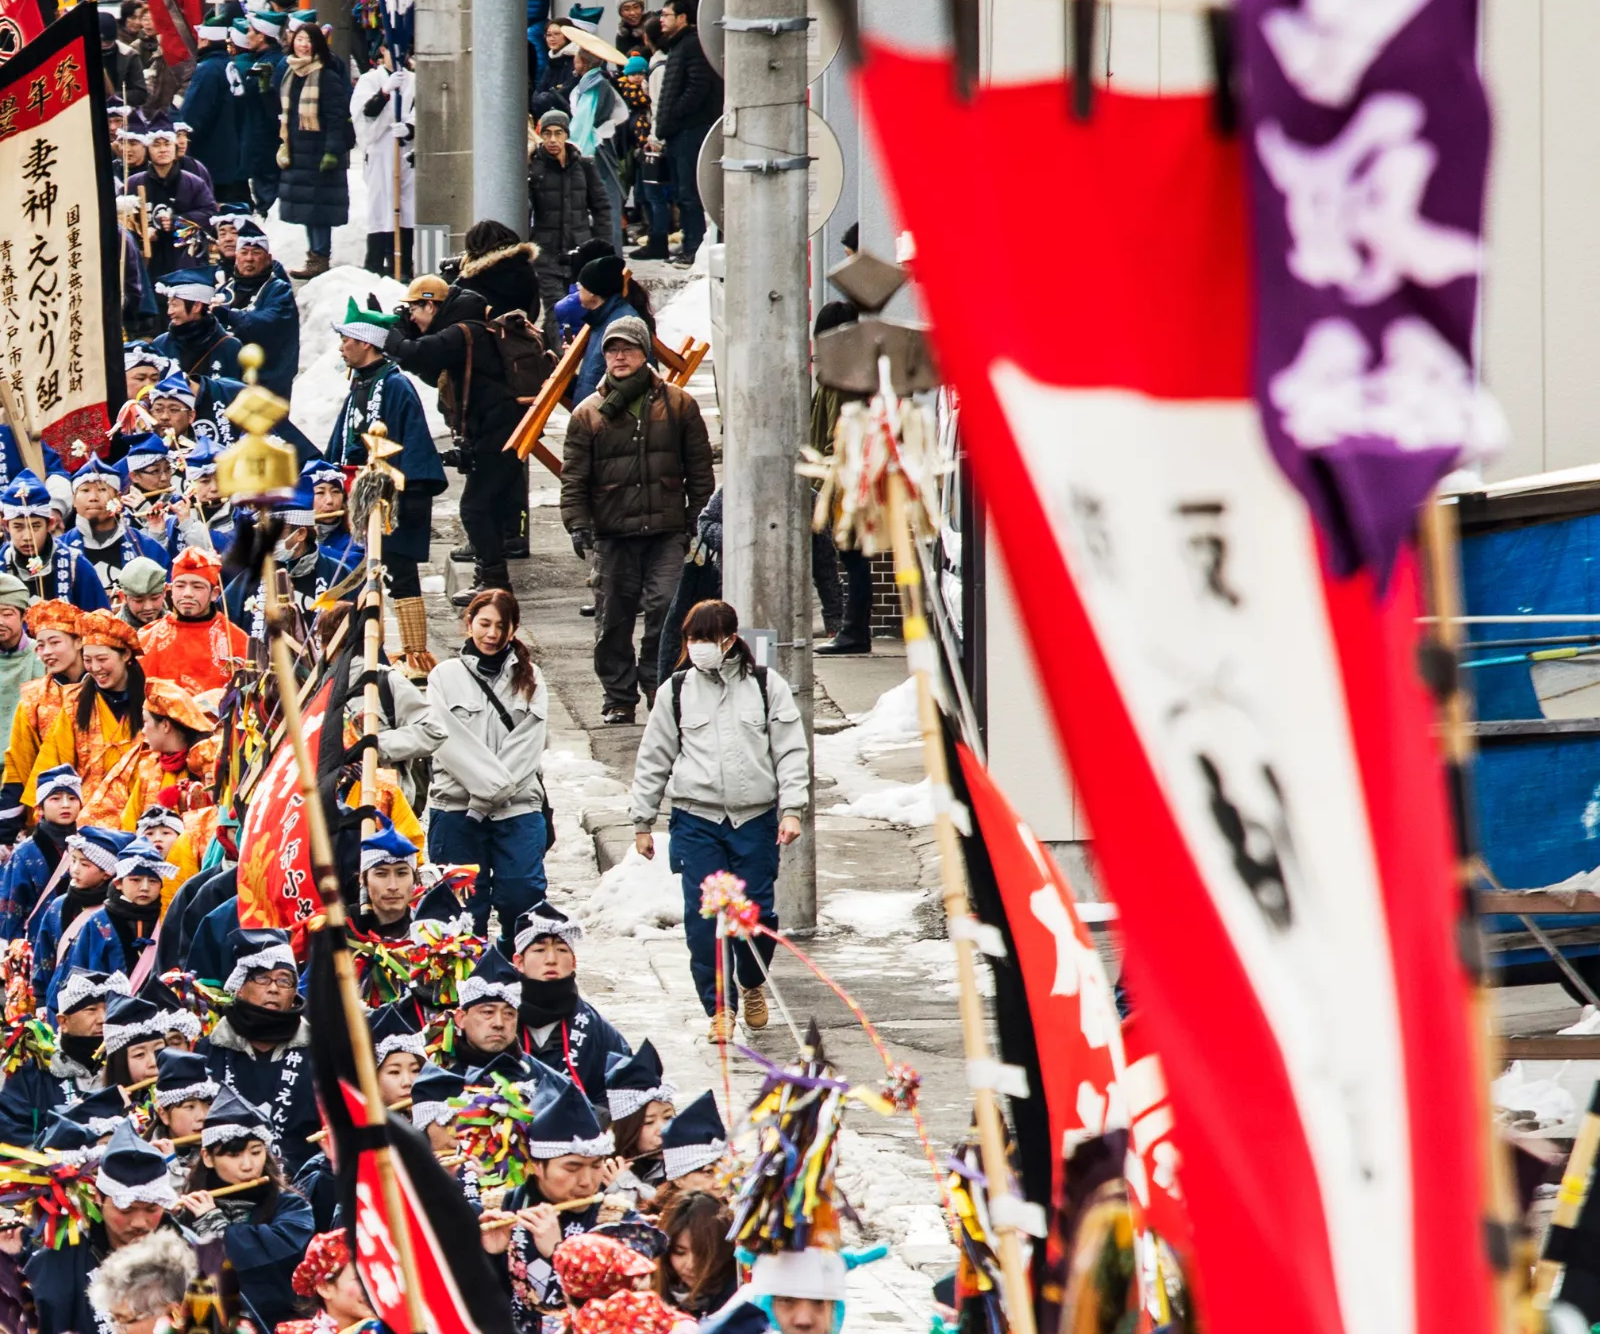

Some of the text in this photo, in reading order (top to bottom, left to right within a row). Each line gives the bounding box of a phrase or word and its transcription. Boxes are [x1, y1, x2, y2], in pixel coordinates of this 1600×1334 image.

[21, 138, 63, 413] 妻神えんぶり組
[66, 203, 85, 395] 国重要無形民俗文化財
